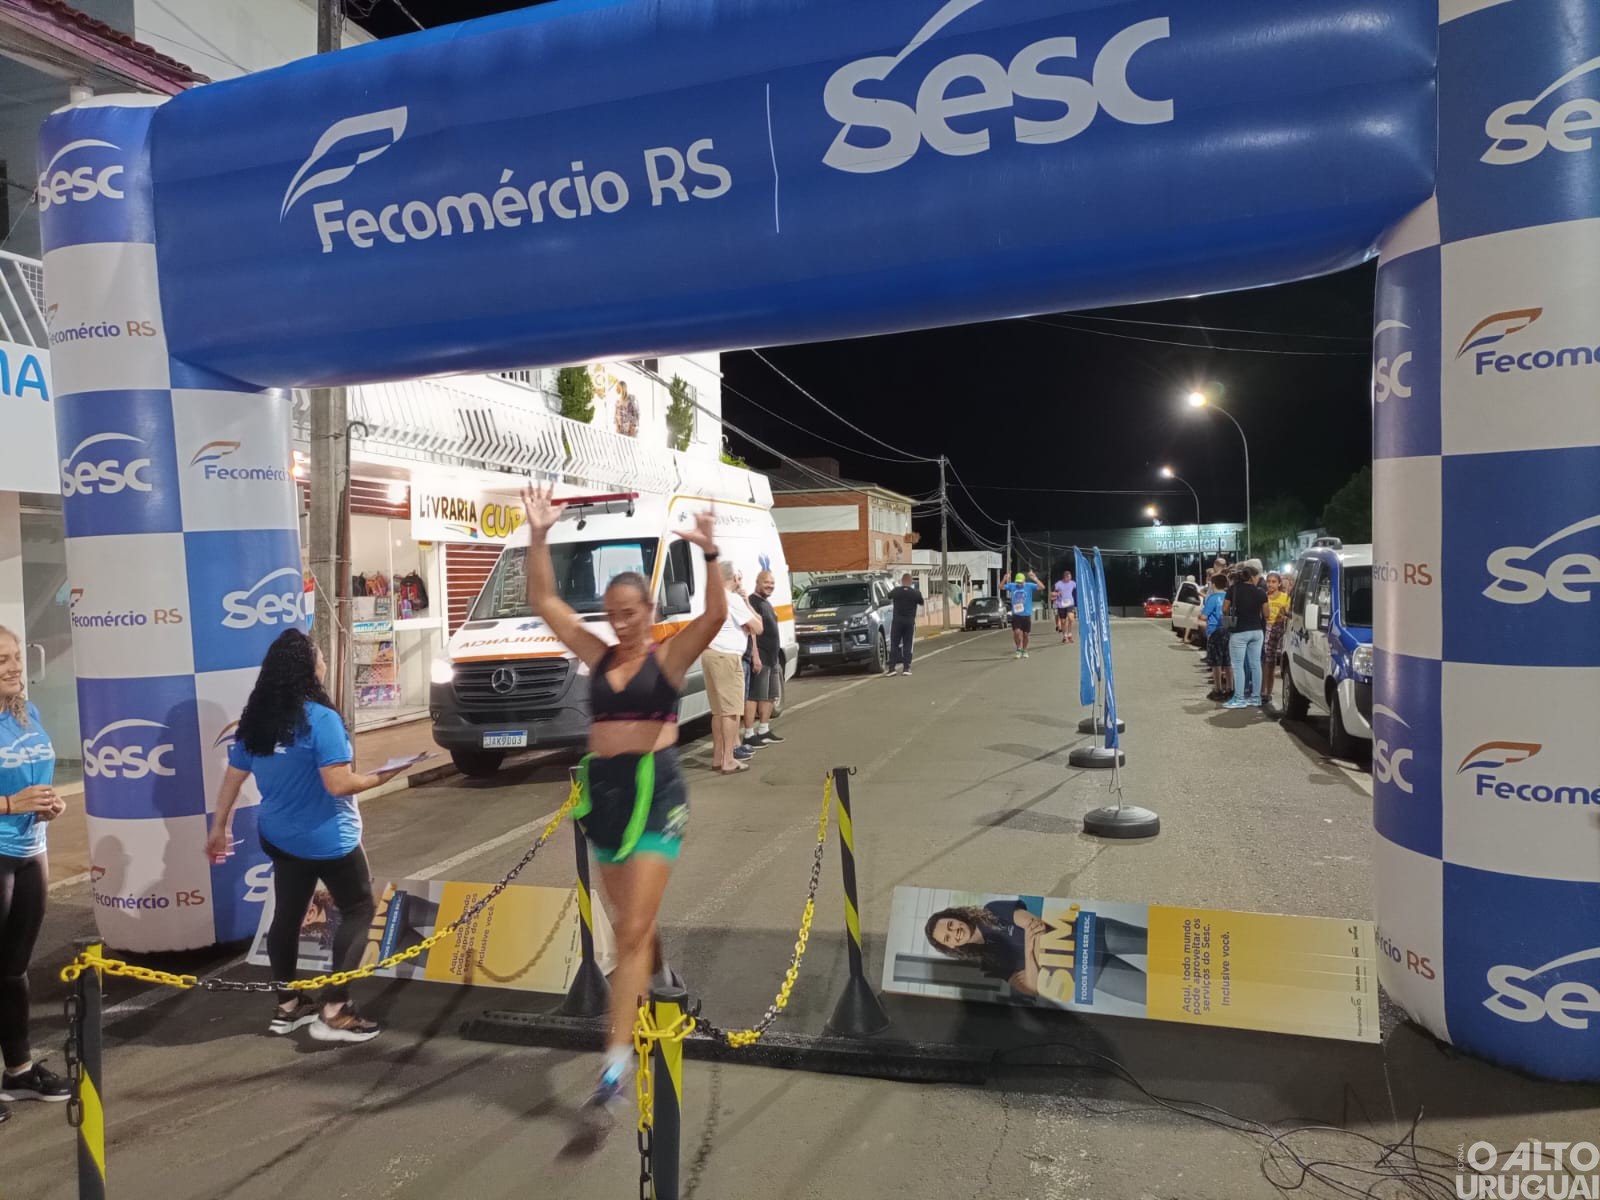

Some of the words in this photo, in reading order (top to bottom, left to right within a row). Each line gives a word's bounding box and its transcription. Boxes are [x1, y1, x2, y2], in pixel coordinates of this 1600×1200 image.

[312, 160, 629, 254] Fecomércio
[643, 138, 732, 207] RS
[125, 320, 156, 337] RS
[1403, 562, 1432, 586] RS
[153, 608, 184, 625] RS
[175, 889, 205, 907] RS
[1181, 919, 1191, 954] mundo
[1192, 918, 1201, 930] os
[1201, 923, 1211, 949] Sesc.
[1201, 951, 1211, 965] do
[1219, 931, 1231, 958] você.
[1181, 957, 1191, 981] todo
[1191, 932, 1202, 985] aproveitar
[1406, 949, 1436, 981] RS
[1202, 968, 1212, 1012] serviços
[1220, 960, 1231, 1006] Inclusive
[1182, 984, 1193, 1013] Aqui,
[1191, 987, 1202, 1015] pode
